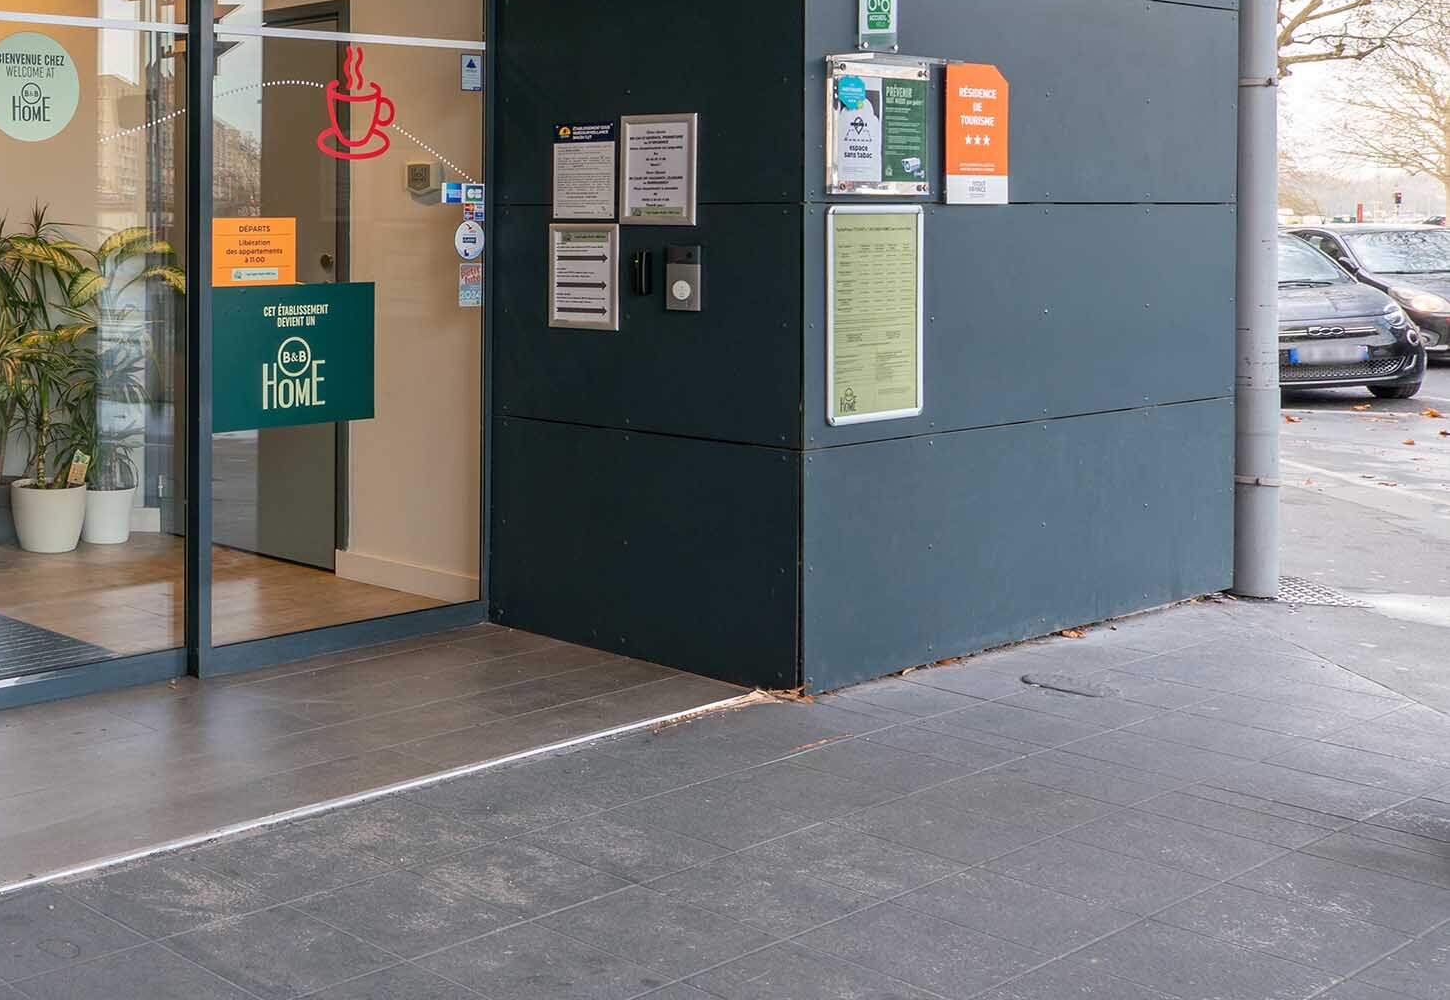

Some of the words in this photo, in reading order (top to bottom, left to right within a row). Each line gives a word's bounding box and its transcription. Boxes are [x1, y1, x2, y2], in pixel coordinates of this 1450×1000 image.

[45, 55, 65, 66] CHEZ
[6, 66, 44, 78] WELCOME
[46, 67, 55, 78] AT
[959, 85, 997, 99] RÉSIDENCE
[973, 102, 982, 112] DE
[960, 115, 995, 126] TOURISME
[856, 151, 872, 159] tabac
[238, 224, 271, 232] DÉPARTS
[263, 306, 276, 316] CET
[278, 304, 328, 316] ÉTABLISSEMENT
[277, 317, 304, 327] DEVIENT
[306, 316, 315, 326] UN
[1307, 326, 1345, 336] 500
[283, 351, 307, 363] B&B
